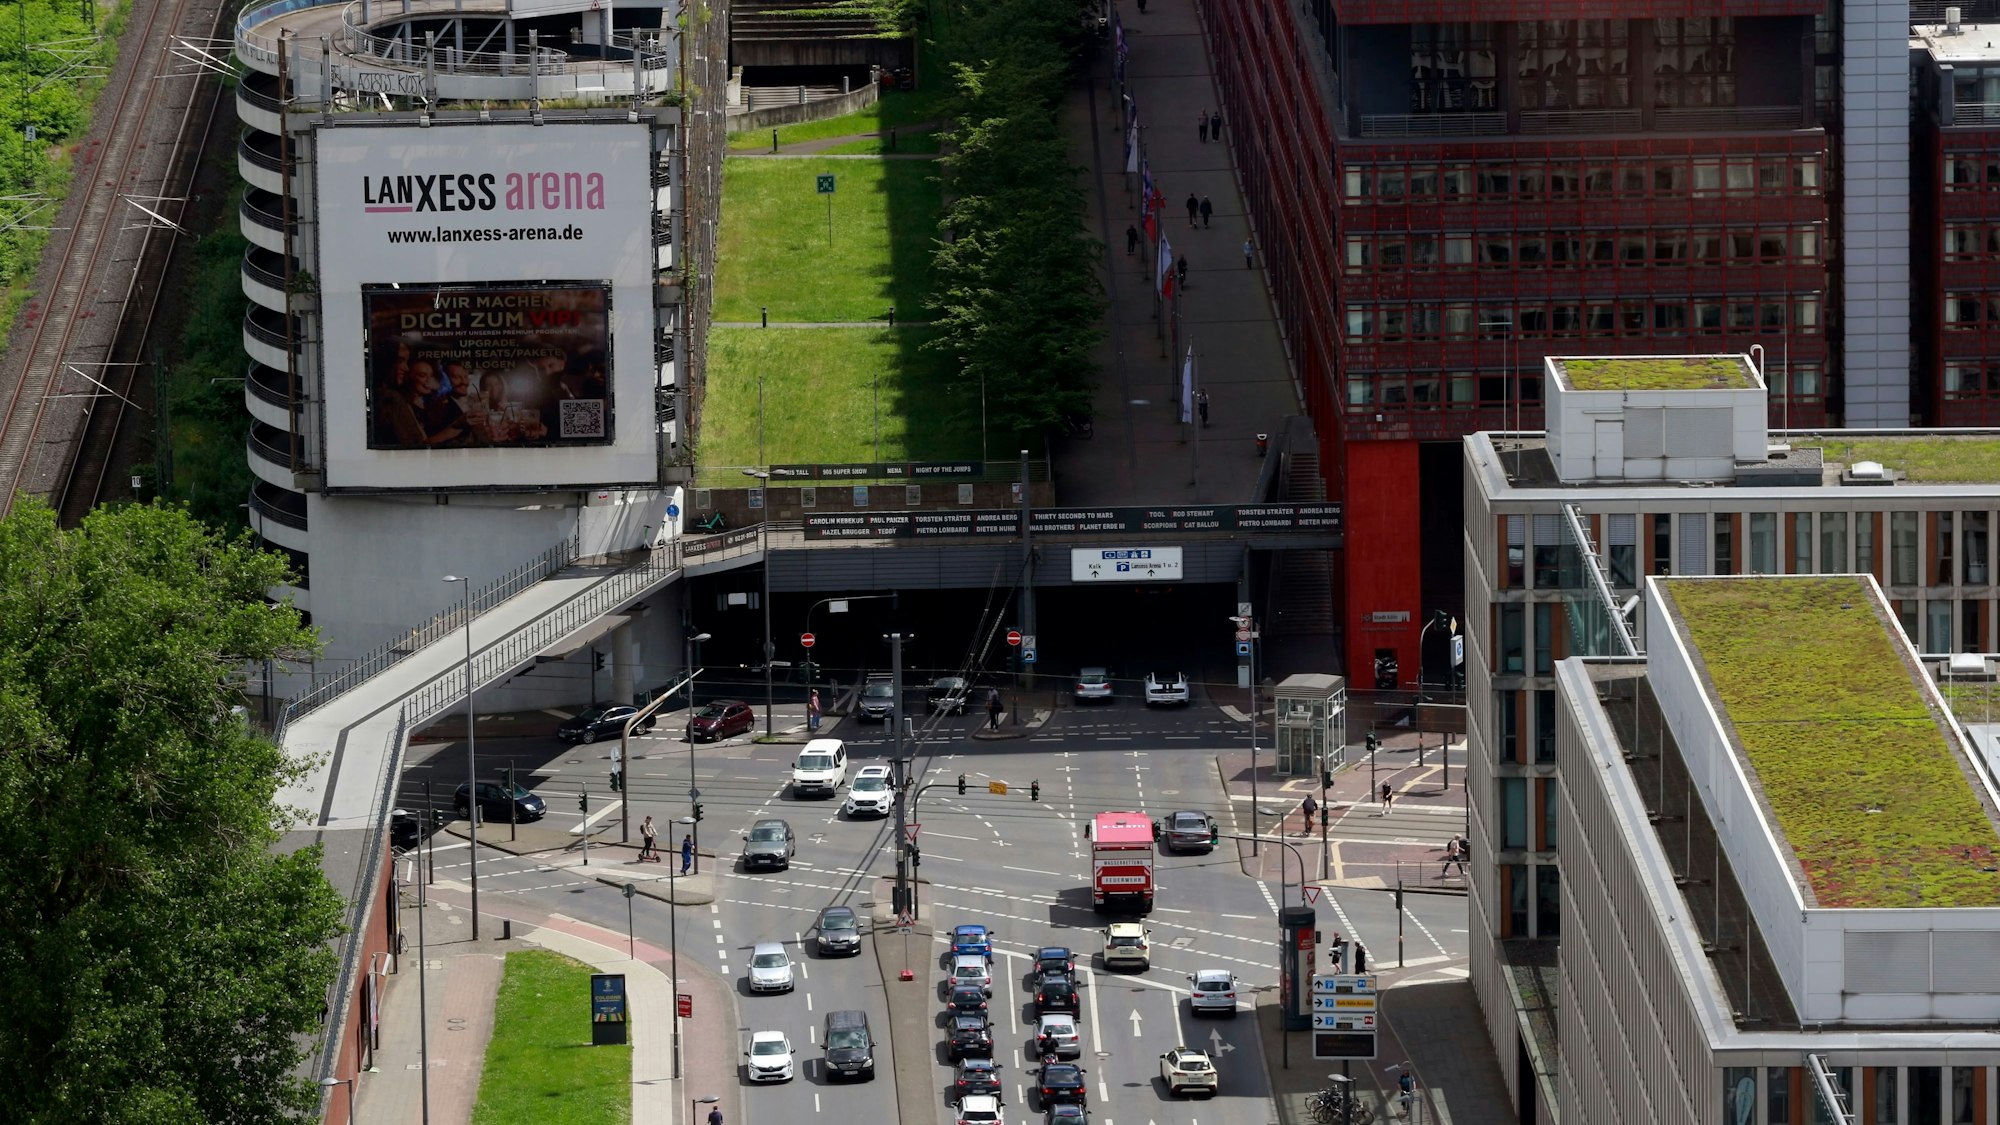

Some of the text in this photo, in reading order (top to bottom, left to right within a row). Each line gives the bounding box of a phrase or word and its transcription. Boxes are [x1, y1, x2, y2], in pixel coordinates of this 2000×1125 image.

[363, 171, 606, 213] LANXESS arena
[387, 223, 584, 244] www.lanxess-arena.de
[477, 296, 553, 309] MACHEN
[400, 312, 461, 329] DICH
[470, 312, 524, 328] ZUM
[418, 348, 562, 359] PREMIUM SEATS/PAKETE
[464, 360, 516, 369] & LOGEN
[1266, 507, 1294, 515] STRÄTER
[809, 517, 836, 525] CAROLIN
[944, 514, 971, 522] STRÄTER
